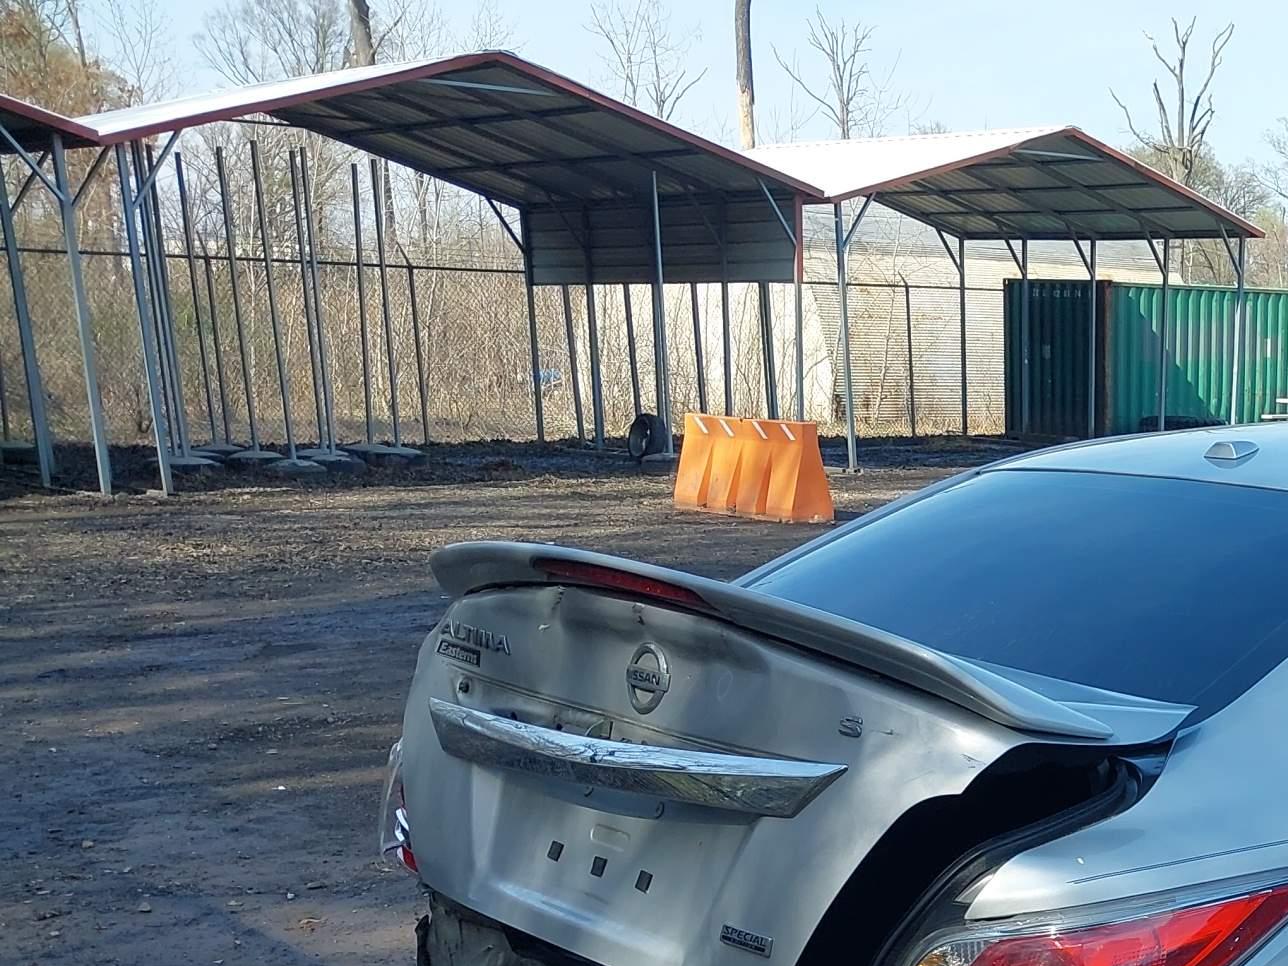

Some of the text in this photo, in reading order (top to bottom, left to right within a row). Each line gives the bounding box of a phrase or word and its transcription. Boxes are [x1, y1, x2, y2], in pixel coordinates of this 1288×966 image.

[441, 616, 511, 656] ALTIMA
[627, 668, 661, 687] SSAN
[838, 715, 864, 738] S
[723, 926, 767, 947] SPECIAL
